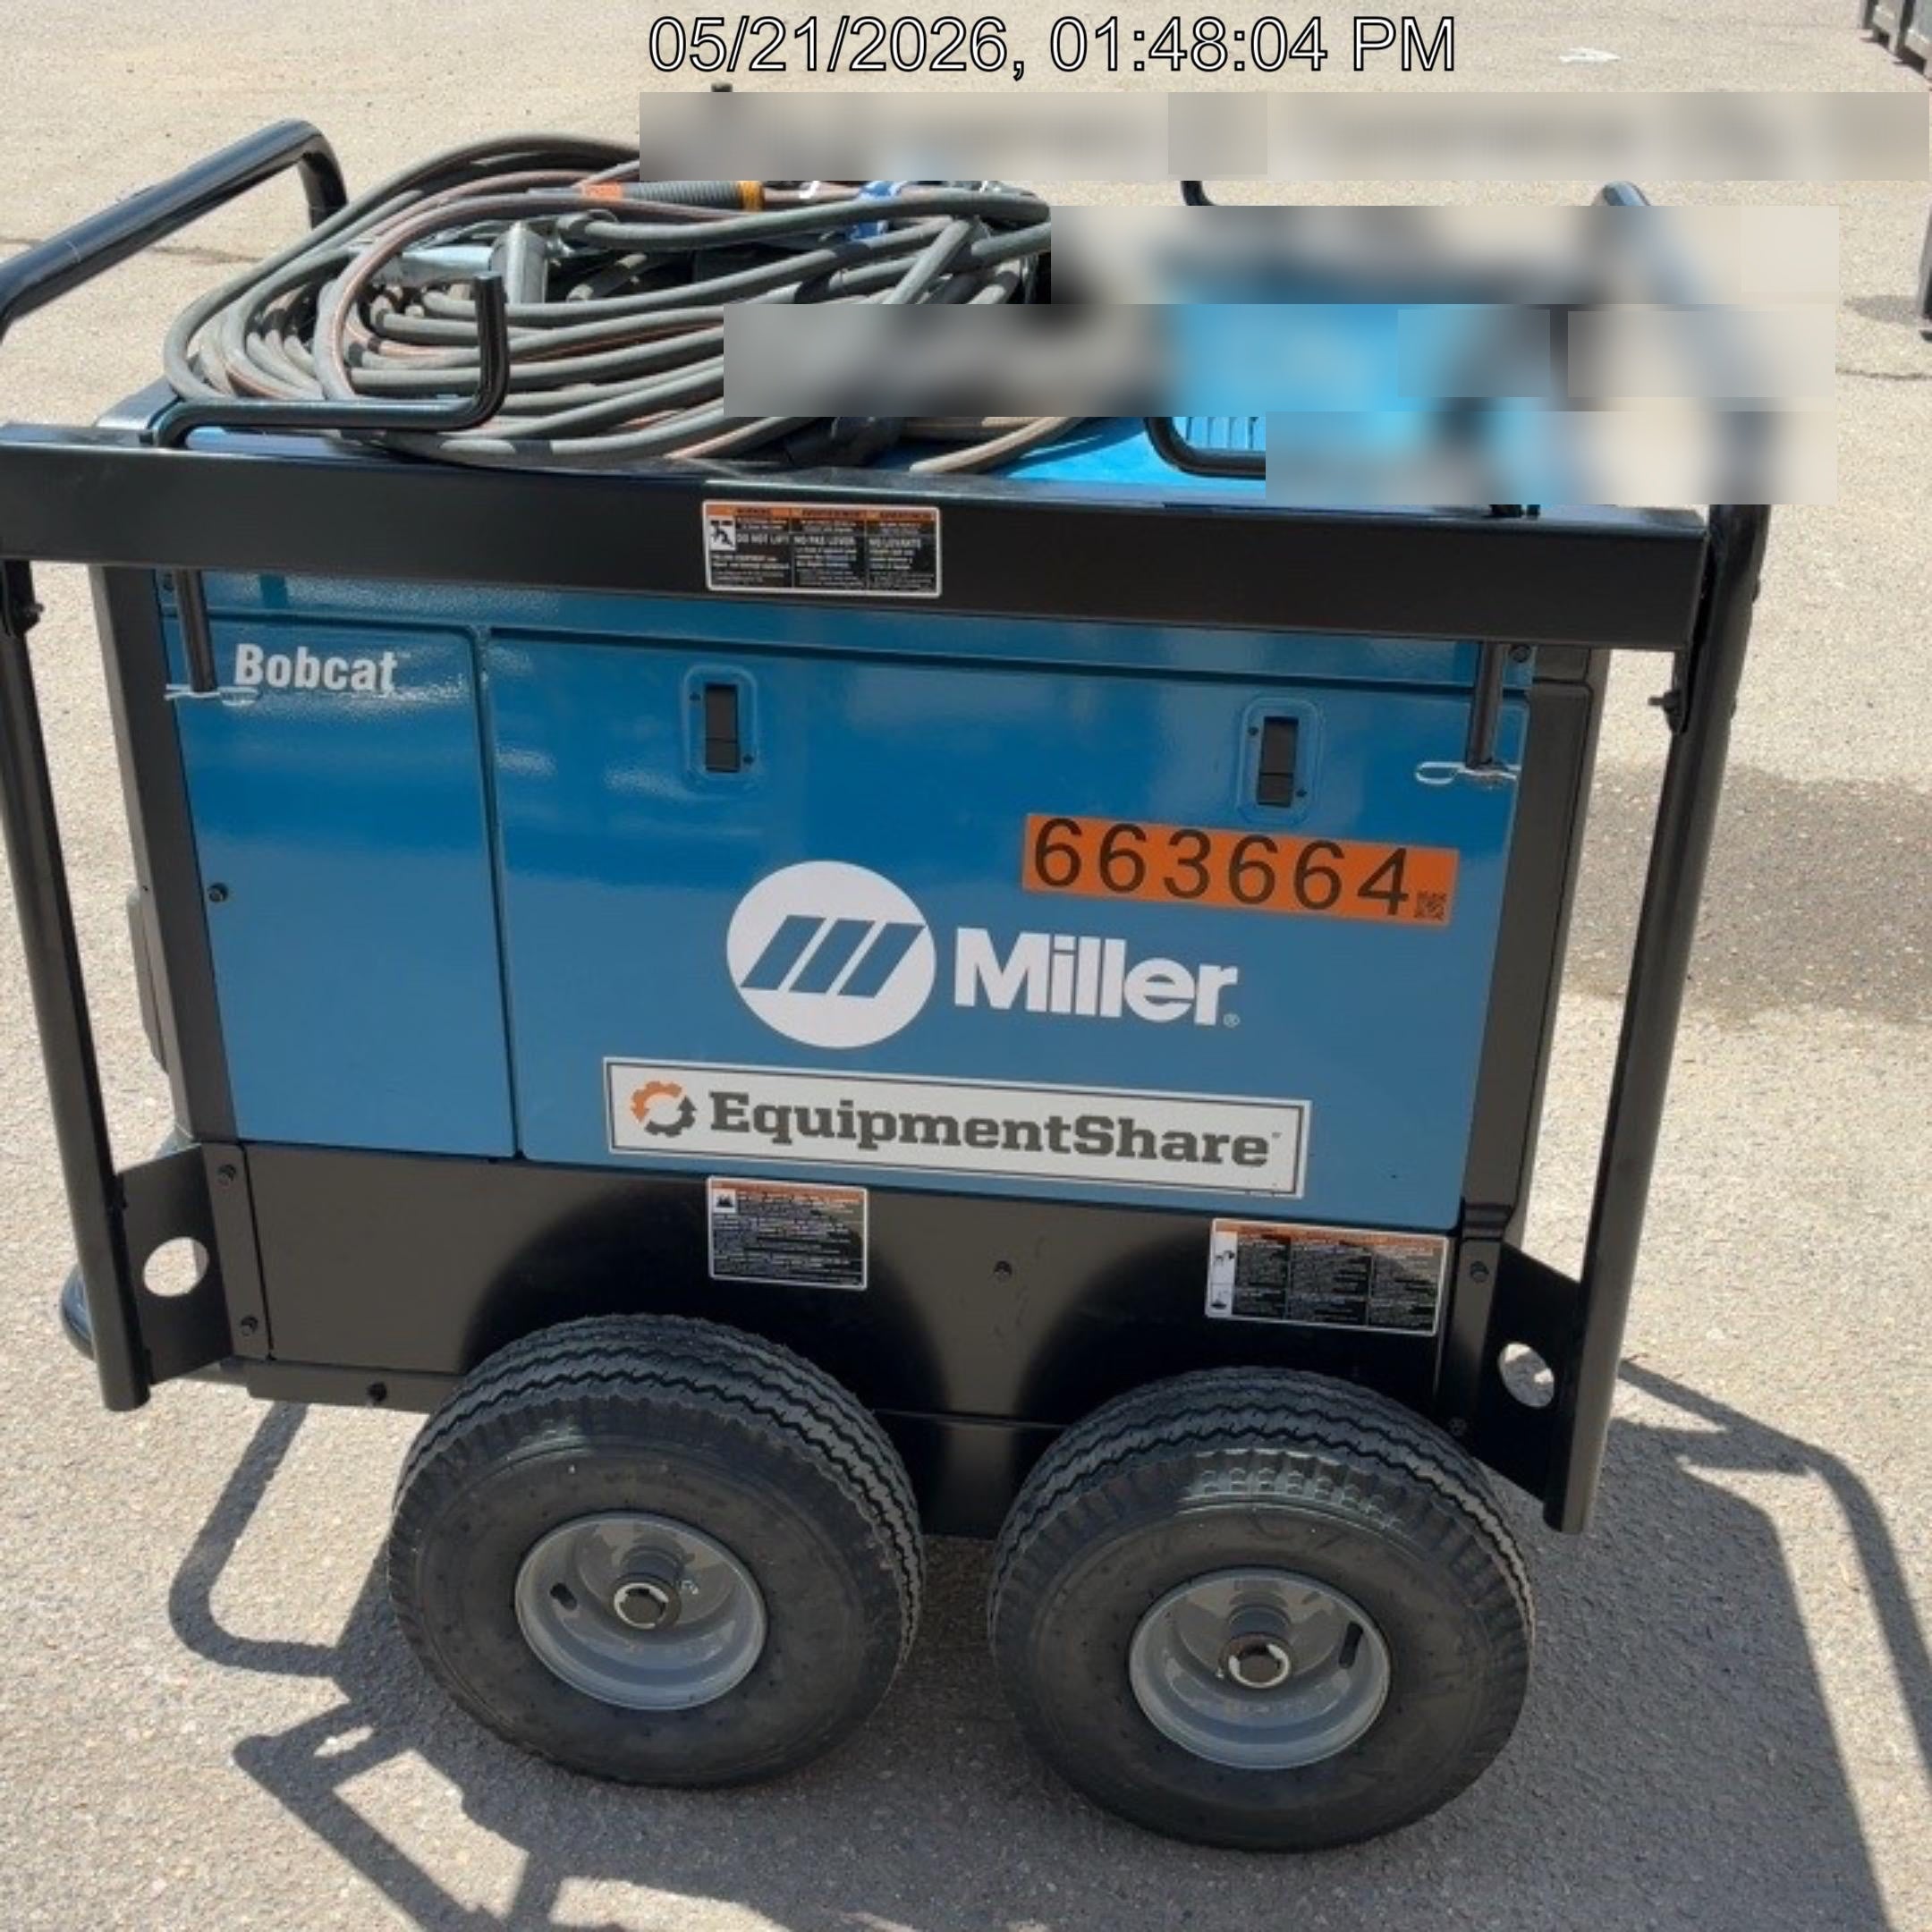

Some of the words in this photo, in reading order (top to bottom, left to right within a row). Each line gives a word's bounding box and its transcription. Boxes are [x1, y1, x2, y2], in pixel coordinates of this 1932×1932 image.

[234, 643, 397, 692] Bobcat
[1035, 818, 1410, 916] 663664
[954, 927, 1239, 1026] Miller
[709, 1090, 1270, 1167] EquipmentShare
